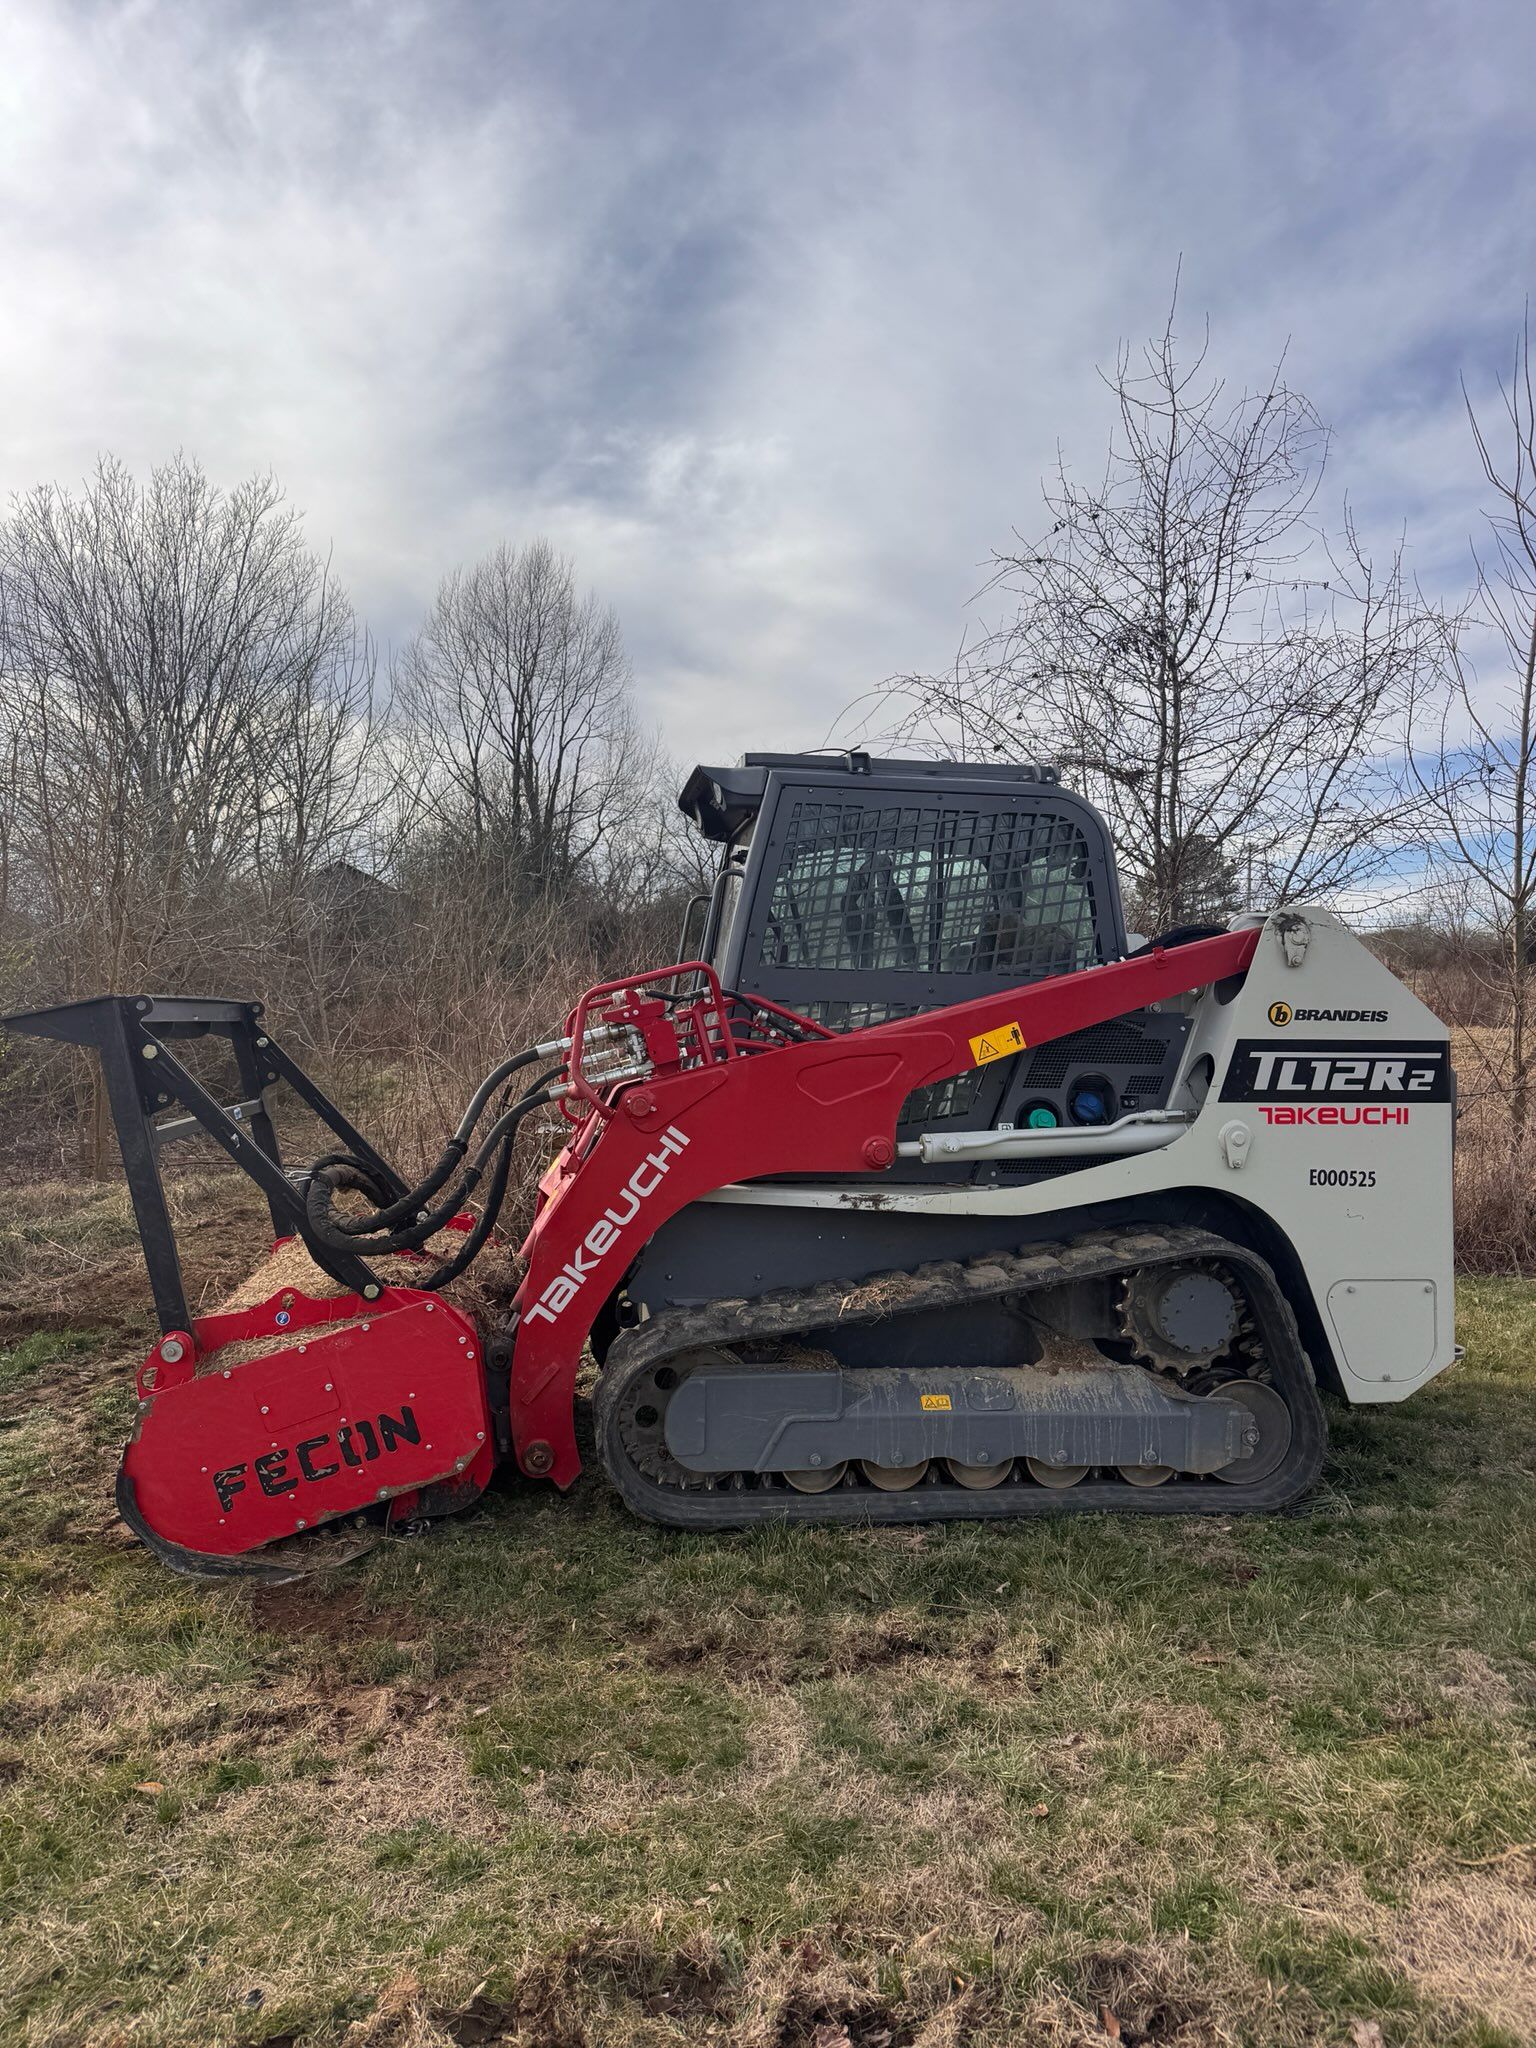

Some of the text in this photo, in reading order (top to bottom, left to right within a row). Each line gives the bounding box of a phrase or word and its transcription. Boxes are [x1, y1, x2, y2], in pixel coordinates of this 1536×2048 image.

[1294, 1009, 1388, 1022] BRANDEIS
[1249, 1052, 1442, 1091] TL12R2
[1258, 1107, 1409, 1125] TAKEUCHI
[1309, 1169, 1376, 1187] E000525
[523, 1125, 691, 1325] TAKEUCHI
[213, 1405, 421, 1513] FECON
